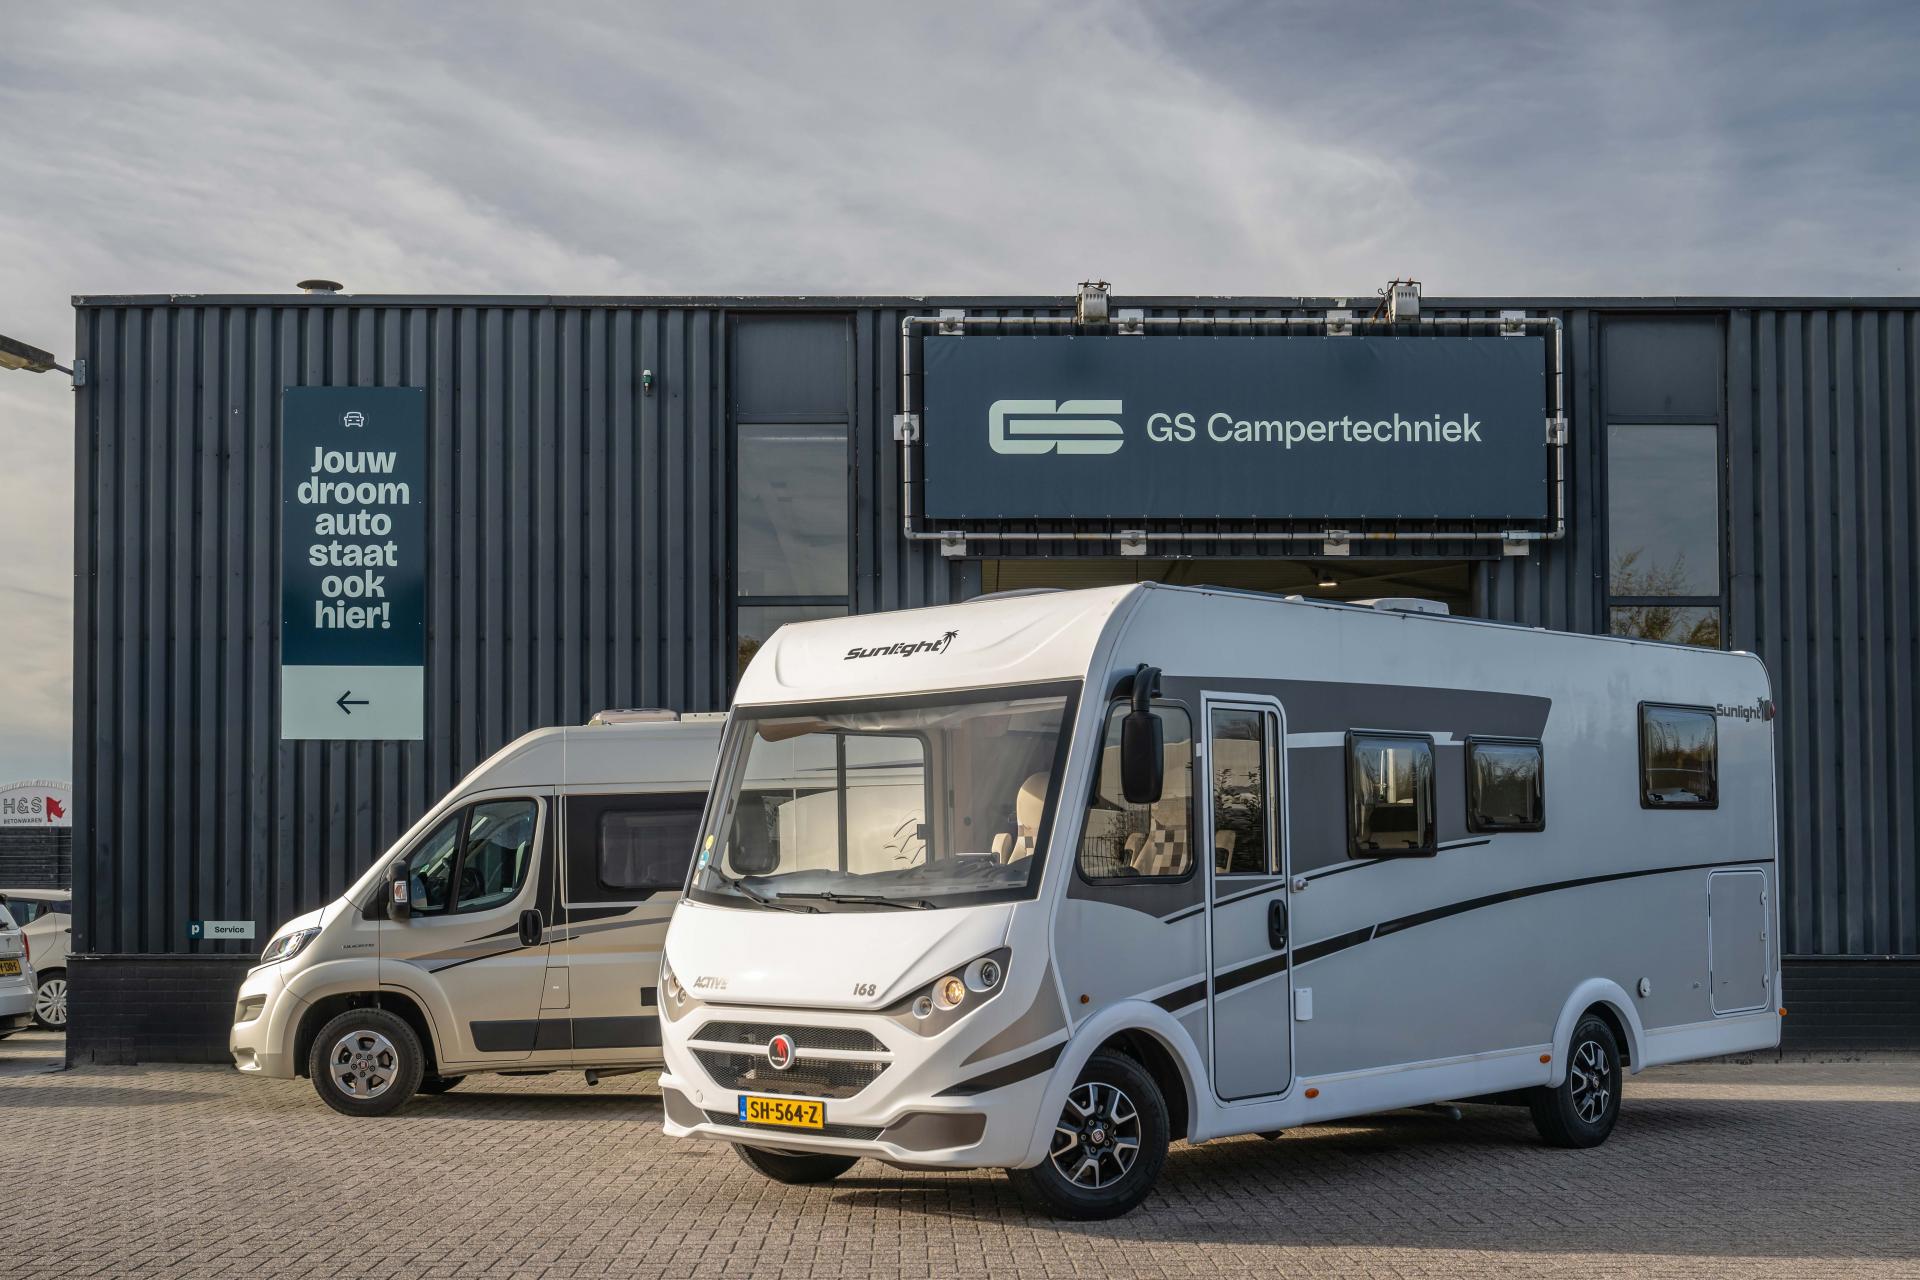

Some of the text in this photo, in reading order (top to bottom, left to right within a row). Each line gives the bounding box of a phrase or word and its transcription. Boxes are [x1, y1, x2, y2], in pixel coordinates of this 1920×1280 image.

[1146, 412, 1482, 450] GS Campertechniek
[311, 446, 397, 473] Jouw
[297, 476, 410, 504] droom
[315, 509, 392, 535] auto
[309, 540, 398, 567] staat
[321, 570, 385, 597] ook
[315, 600, 390, 629] hier!
[844, 639, 943, 660] Sunlight
[1716, 703, 1761, 722] Sunlight
[3, 796, 42, 814] H&S
[3, 817, 43, 825] BETONWAREN
[214, 925, 245, 933] Service
[750, 1101, 818, 1124] SH-564-Z
